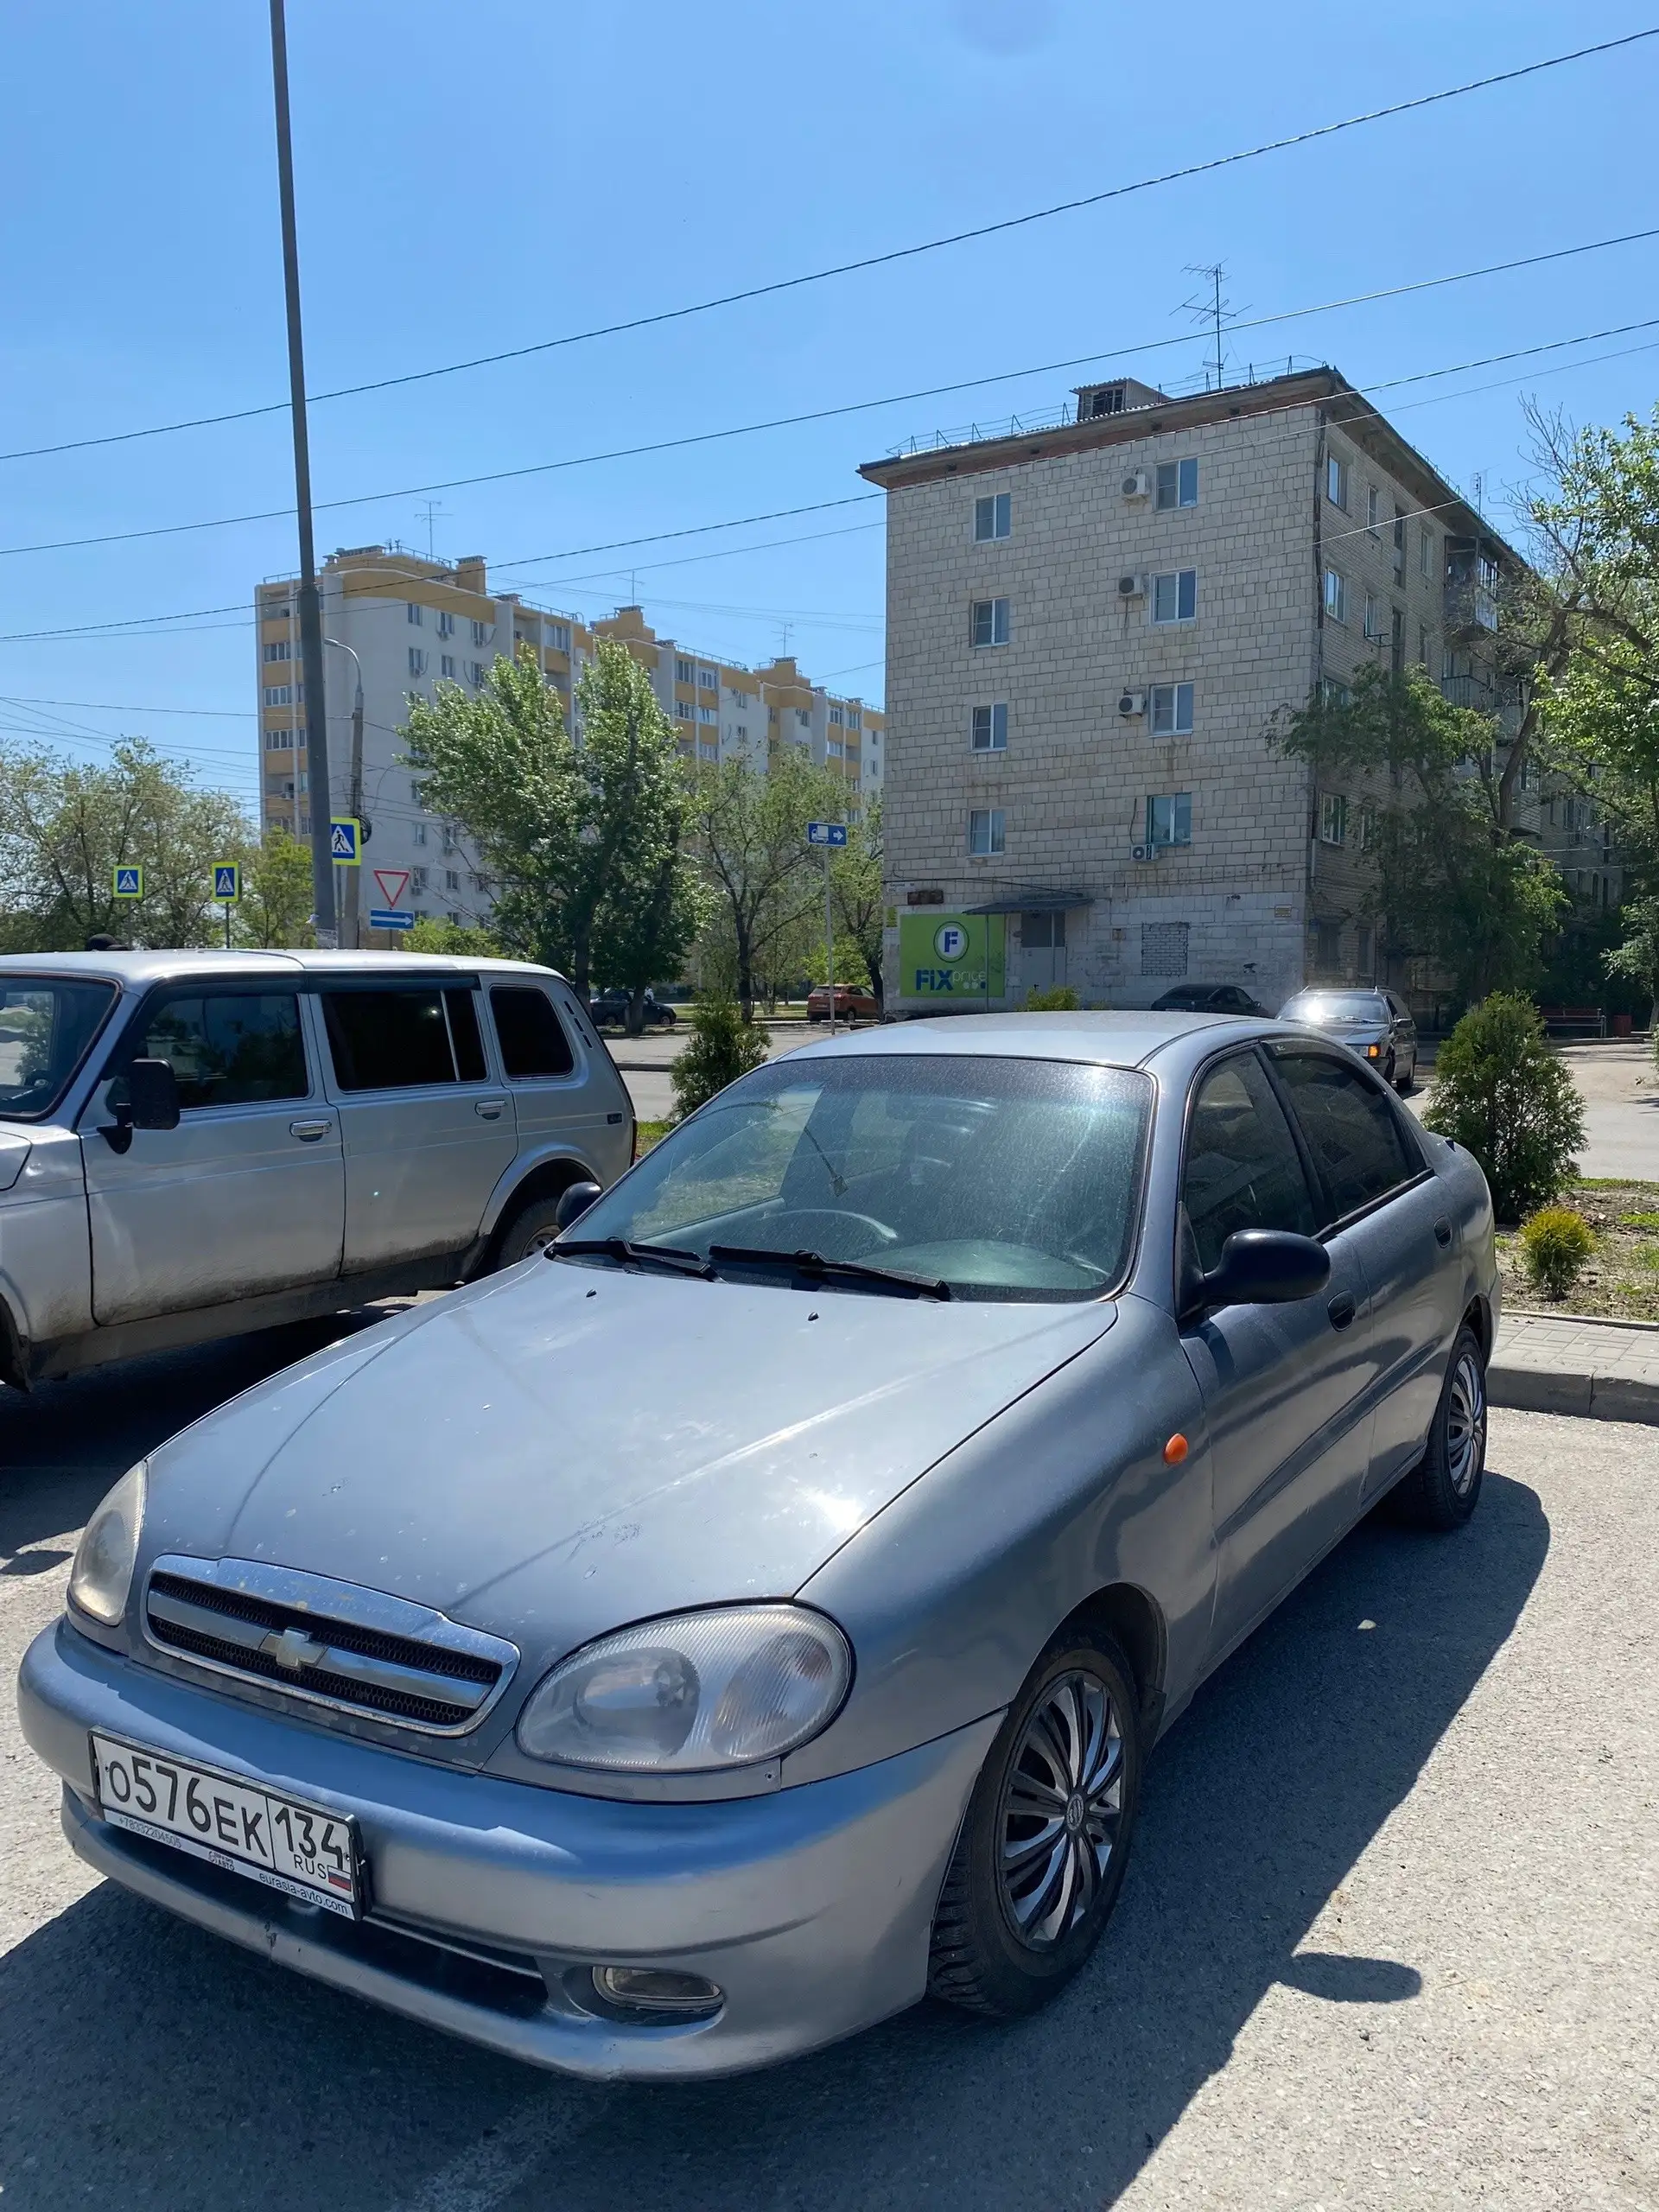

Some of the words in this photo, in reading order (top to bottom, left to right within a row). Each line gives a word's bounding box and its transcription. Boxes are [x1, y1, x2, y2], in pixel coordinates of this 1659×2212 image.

[944, 931, 958, 952] F
[952, 969, 986, 983] price
[275, 1807, 343, 1871] 134
[293, 1854, 327, 1880] RUS
[259, 1872, 348, 1914] eurasia-avto.com
